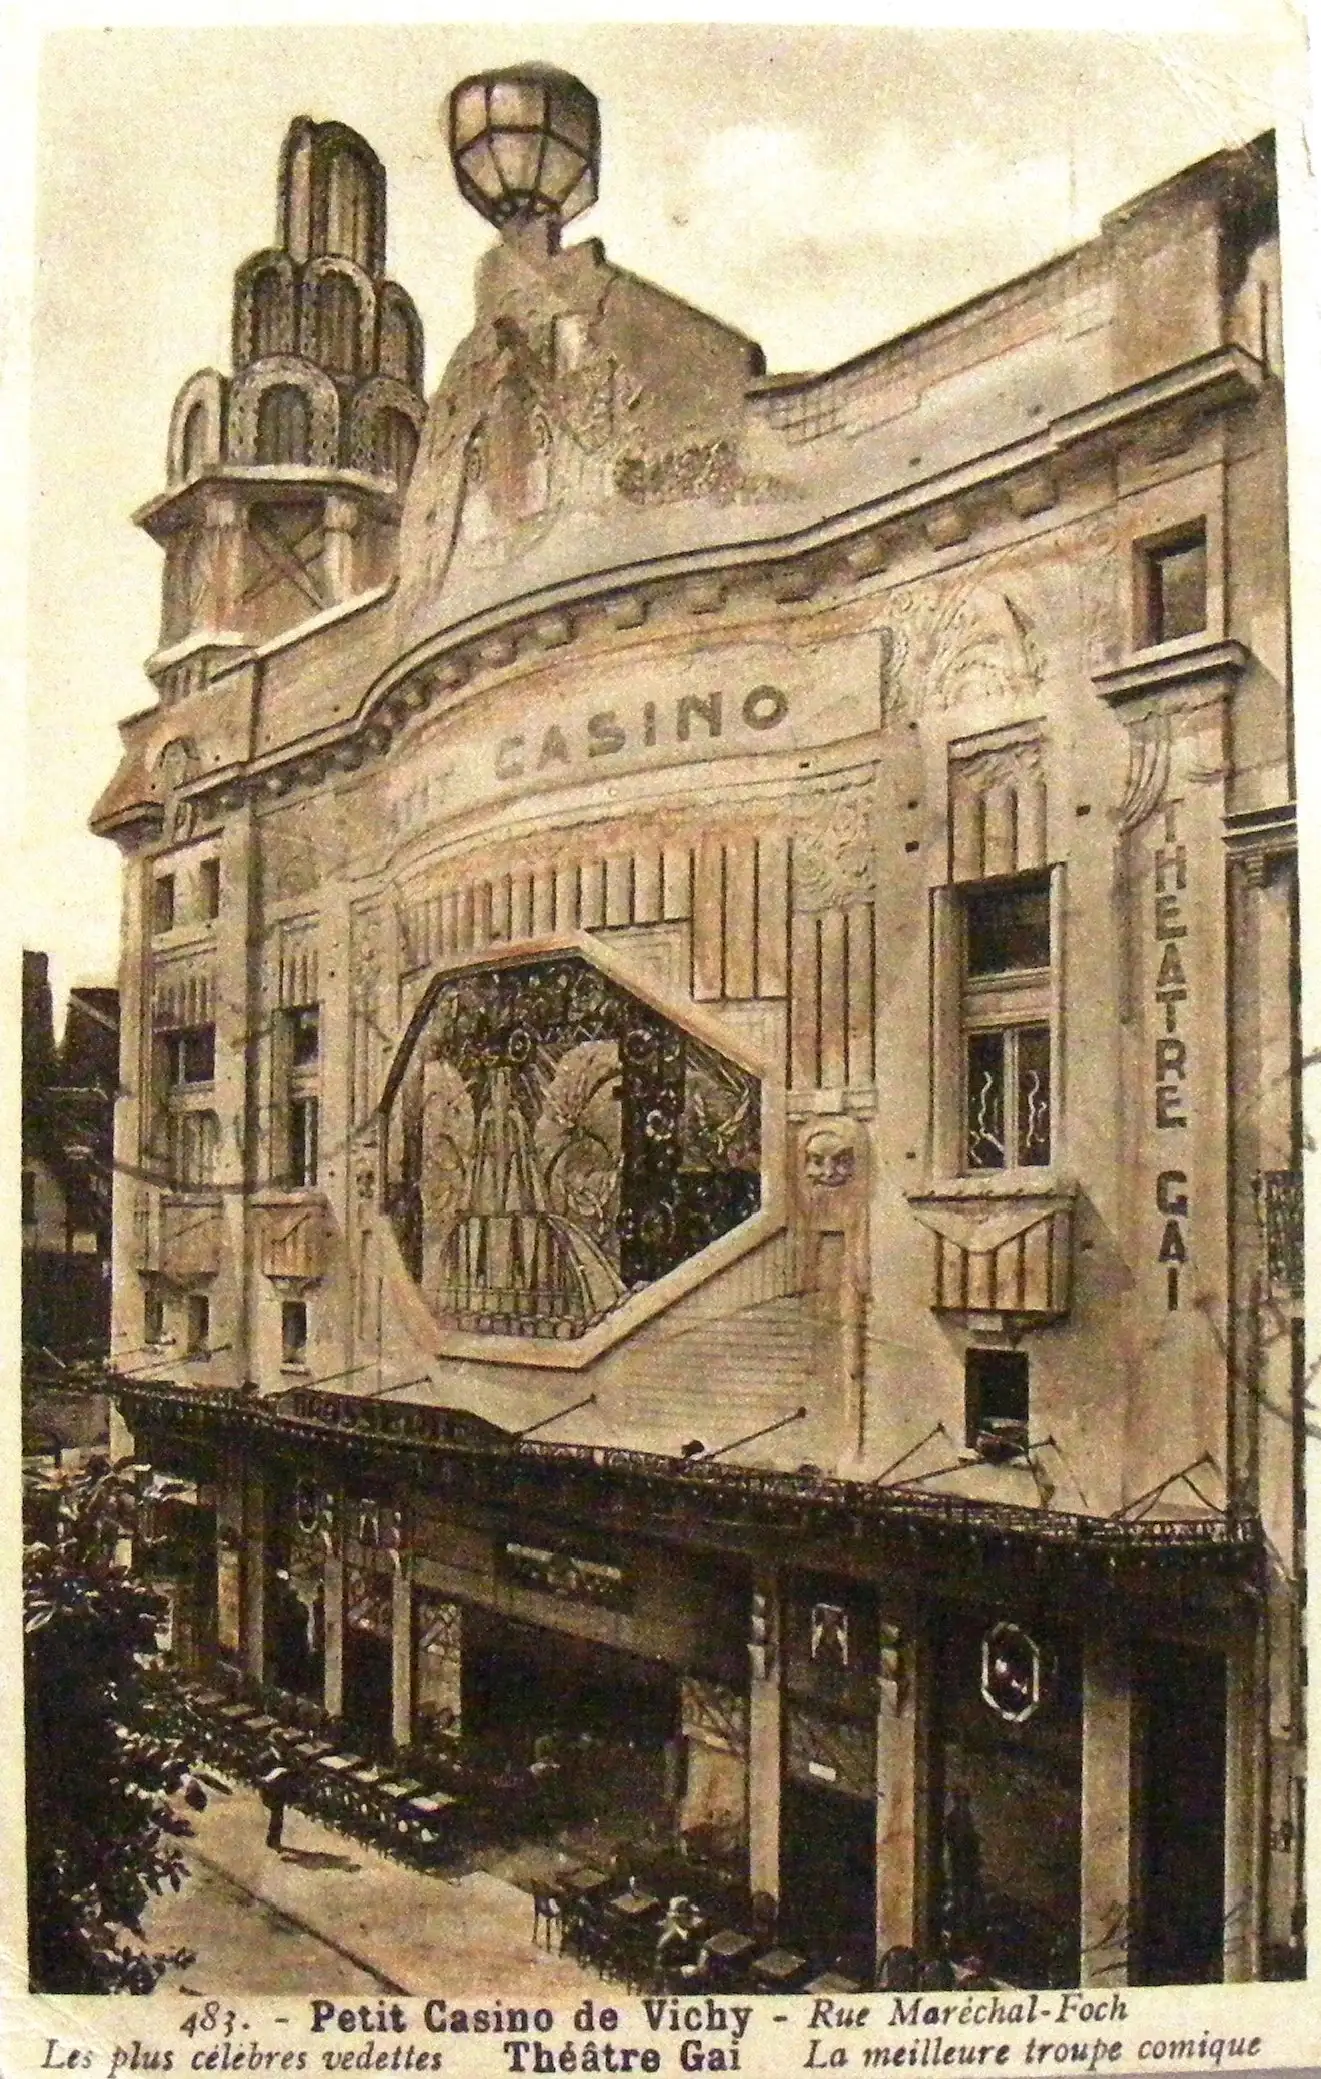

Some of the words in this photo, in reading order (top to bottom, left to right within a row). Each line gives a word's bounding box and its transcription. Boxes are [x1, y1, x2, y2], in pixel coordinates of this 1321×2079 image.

[494, 683, 789, 781] CASINO
[1155, 797, 1188, 1130] THEATRE
[1156, 1170, 1188, 1312] GAI
